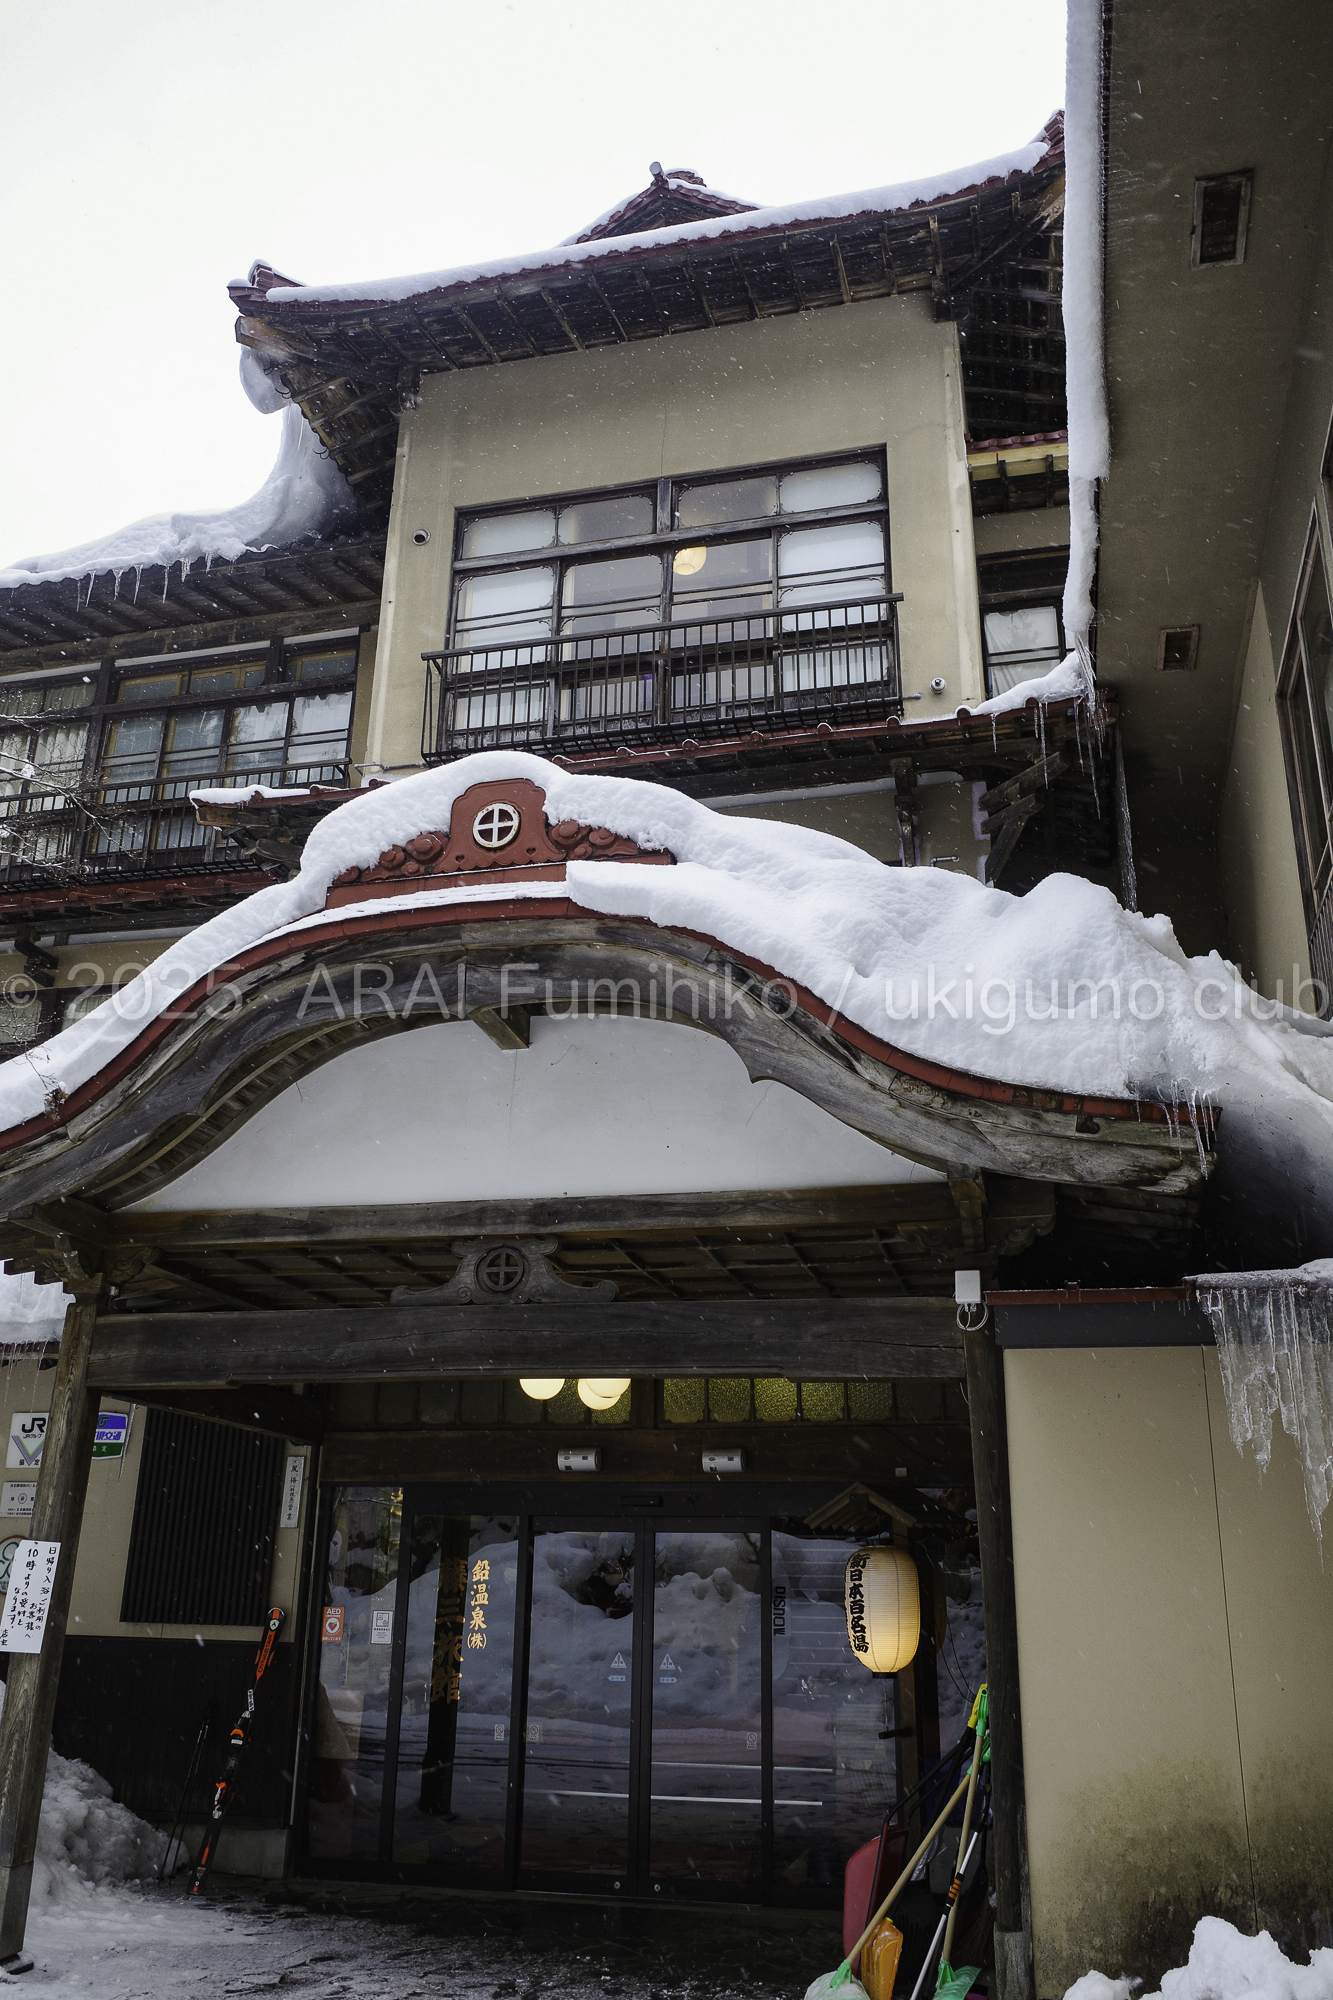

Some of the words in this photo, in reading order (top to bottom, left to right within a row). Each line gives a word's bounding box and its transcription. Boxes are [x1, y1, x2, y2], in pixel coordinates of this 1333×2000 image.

[21, 1417, 47, 1434] JR
[430, 1556, 469, 1705] 藤三旅館
[849, 1553, 871, 1654] 新日本百名湯
[257, 1634, 274, 1673] DYNASTAR
